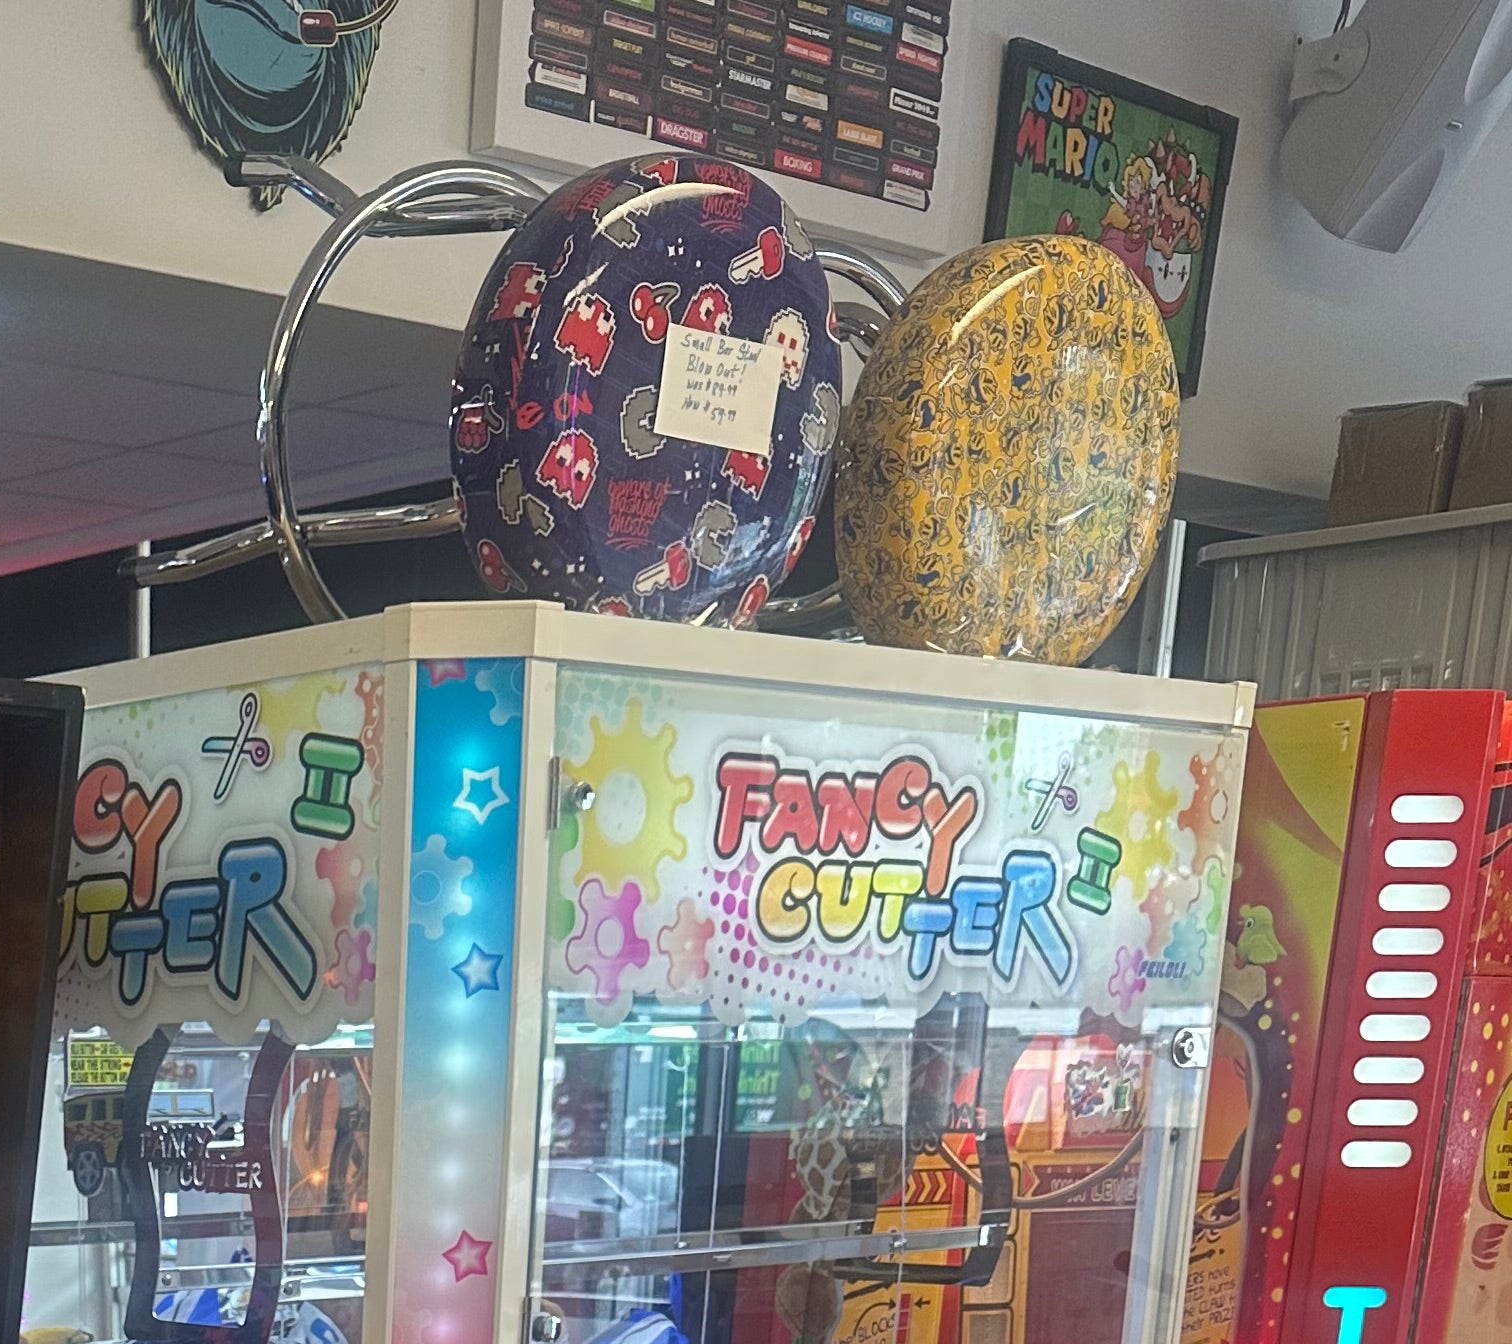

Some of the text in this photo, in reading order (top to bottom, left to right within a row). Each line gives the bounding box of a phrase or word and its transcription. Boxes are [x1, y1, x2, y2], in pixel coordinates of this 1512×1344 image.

[1031, 72, 1115, 136] SUPER
[660, 120, 704, 145] DRAGSTER
[1016, 109, 1119, 196] MARIO
[782, 155, 813, 174] BOXING
[680, 332, 714, 352] Small
[686, 353, 713, 376] Blow
[715, 752, 979, 897] FANCY
[755, 850, 1073, 985] CUTTER
